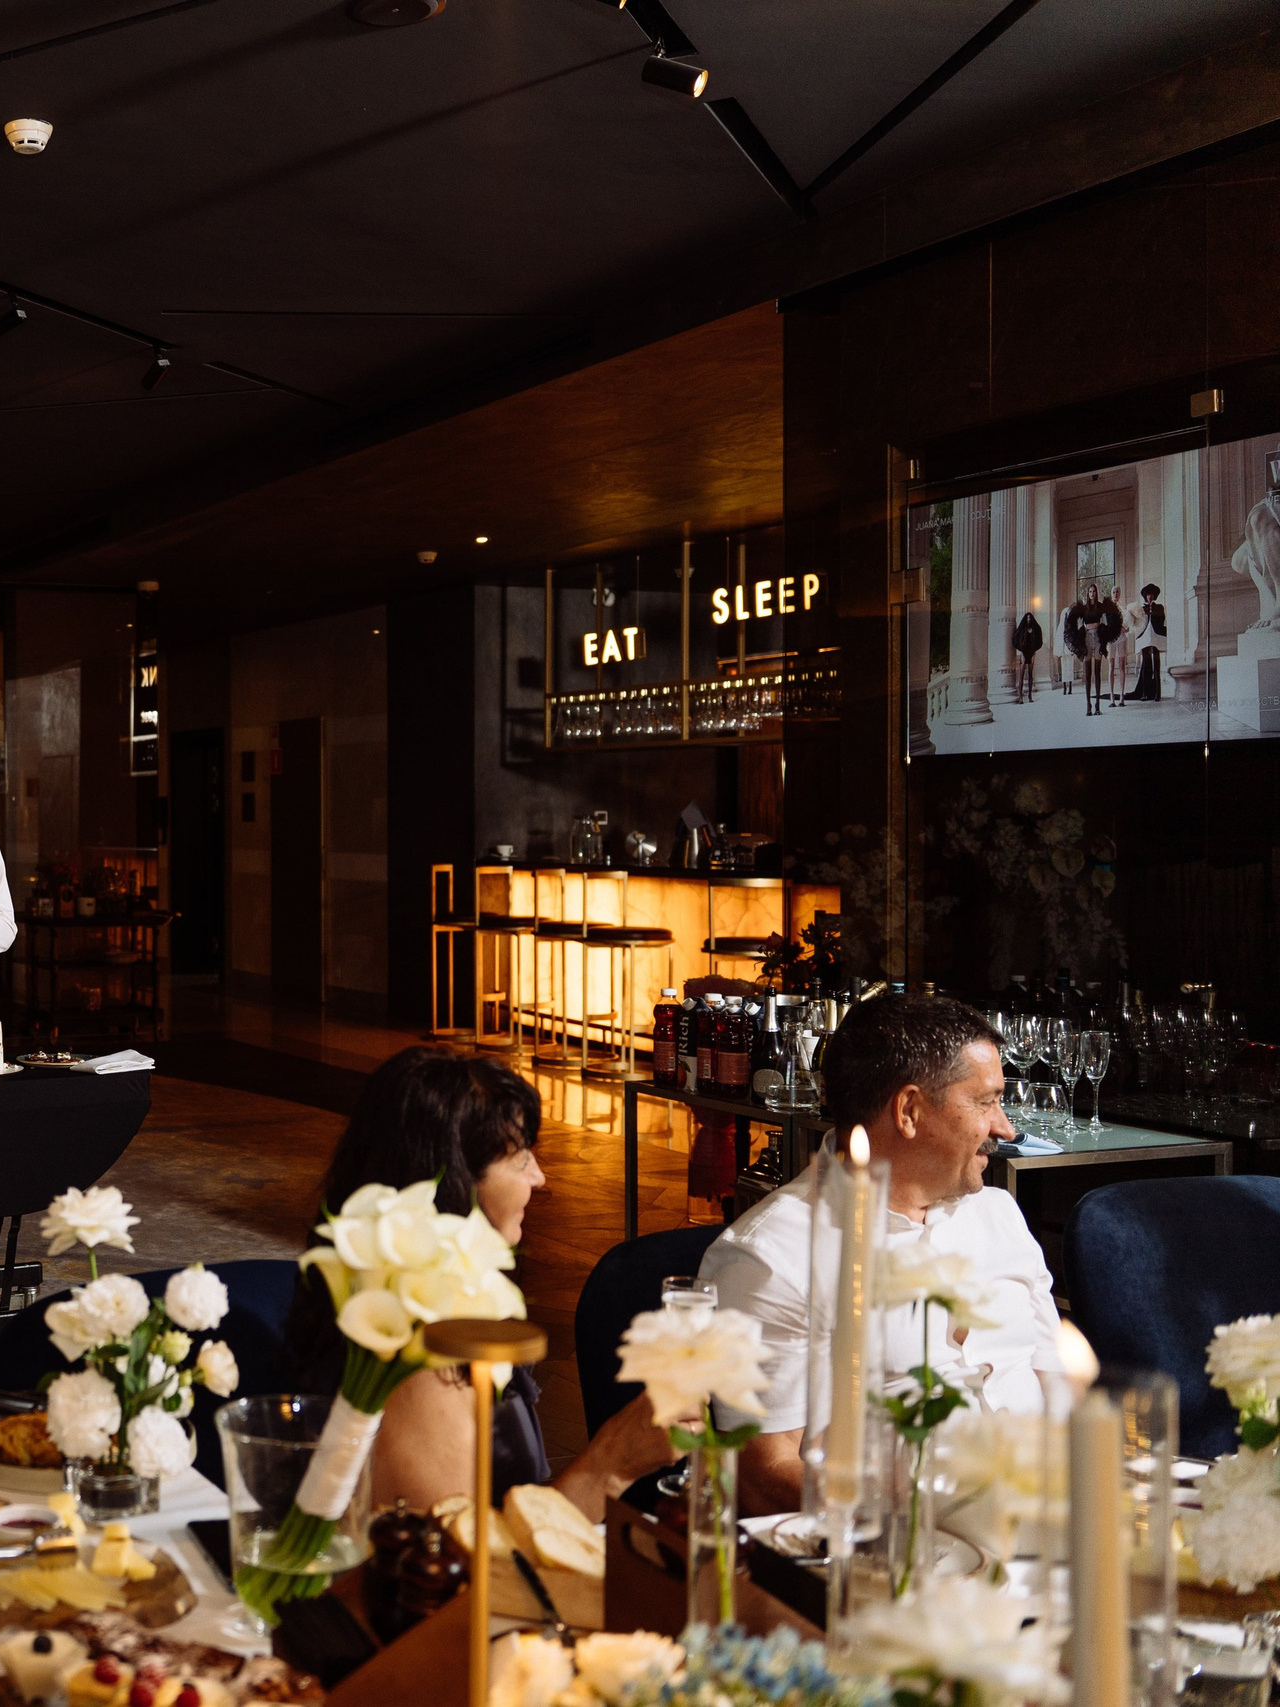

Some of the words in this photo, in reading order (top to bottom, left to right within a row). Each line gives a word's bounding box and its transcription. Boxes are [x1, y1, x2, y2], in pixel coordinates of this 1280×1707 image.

[712, 573, 820, 625] SLEEP
[583, 626, 639, 667] EAT
[1190, 701, 1218, 711] МОА
[678, 1016, 690, 1054] Rich
